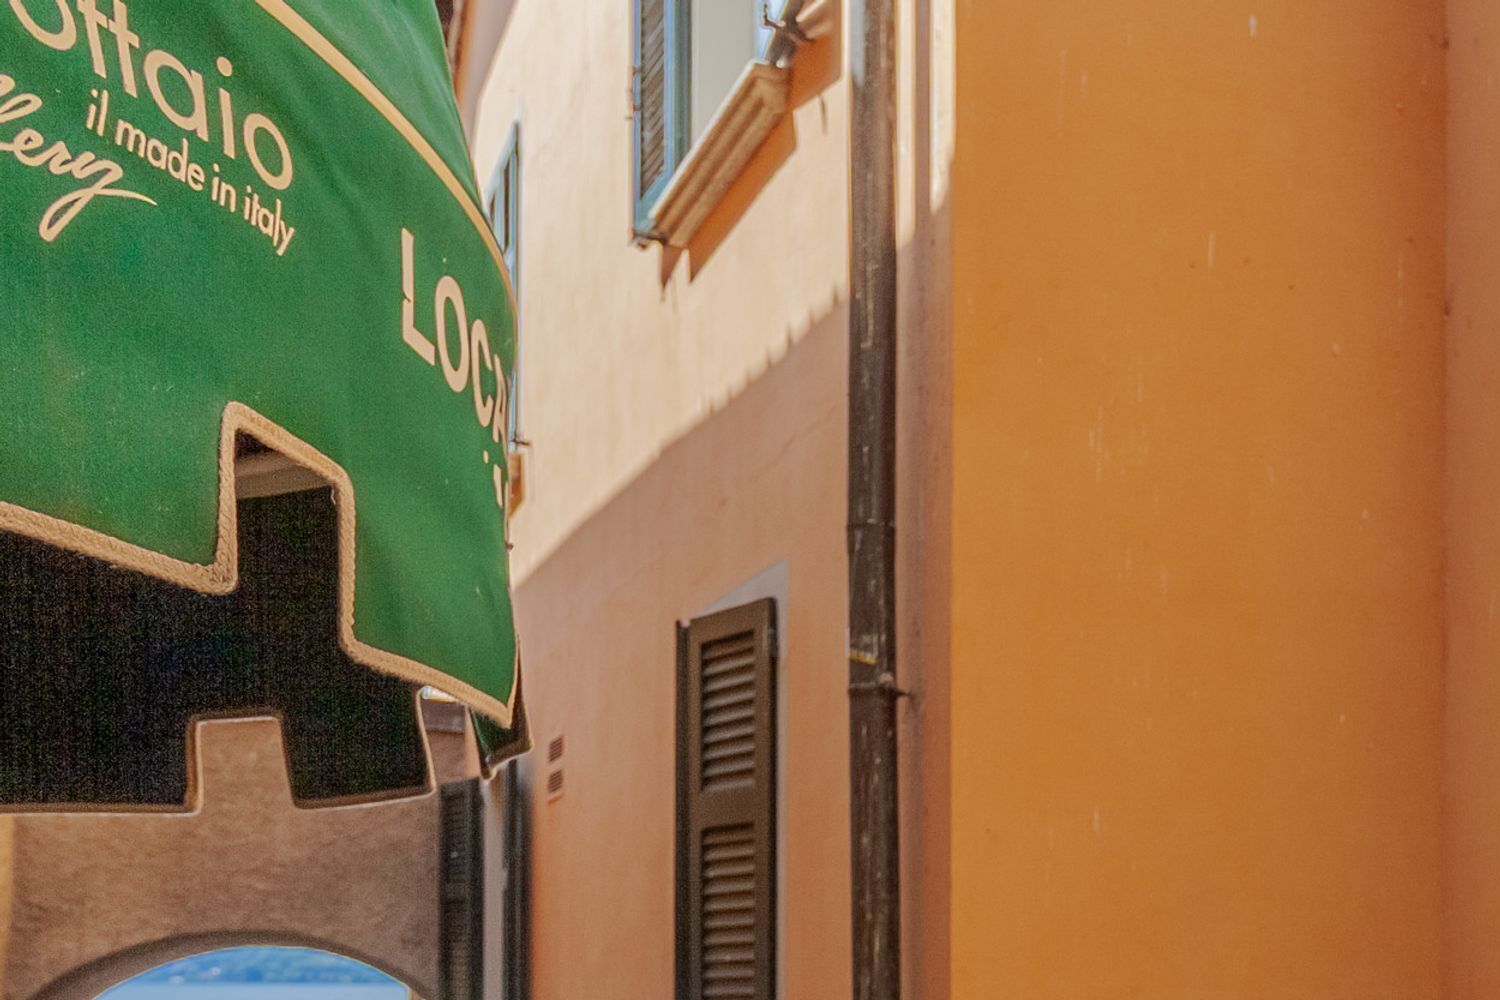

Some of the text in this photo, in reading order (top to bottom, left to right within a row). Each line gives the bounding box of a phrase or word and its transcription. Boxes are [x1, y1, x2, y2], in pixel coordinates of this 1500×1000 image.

[86, 88, 295, 256] il made in italy
